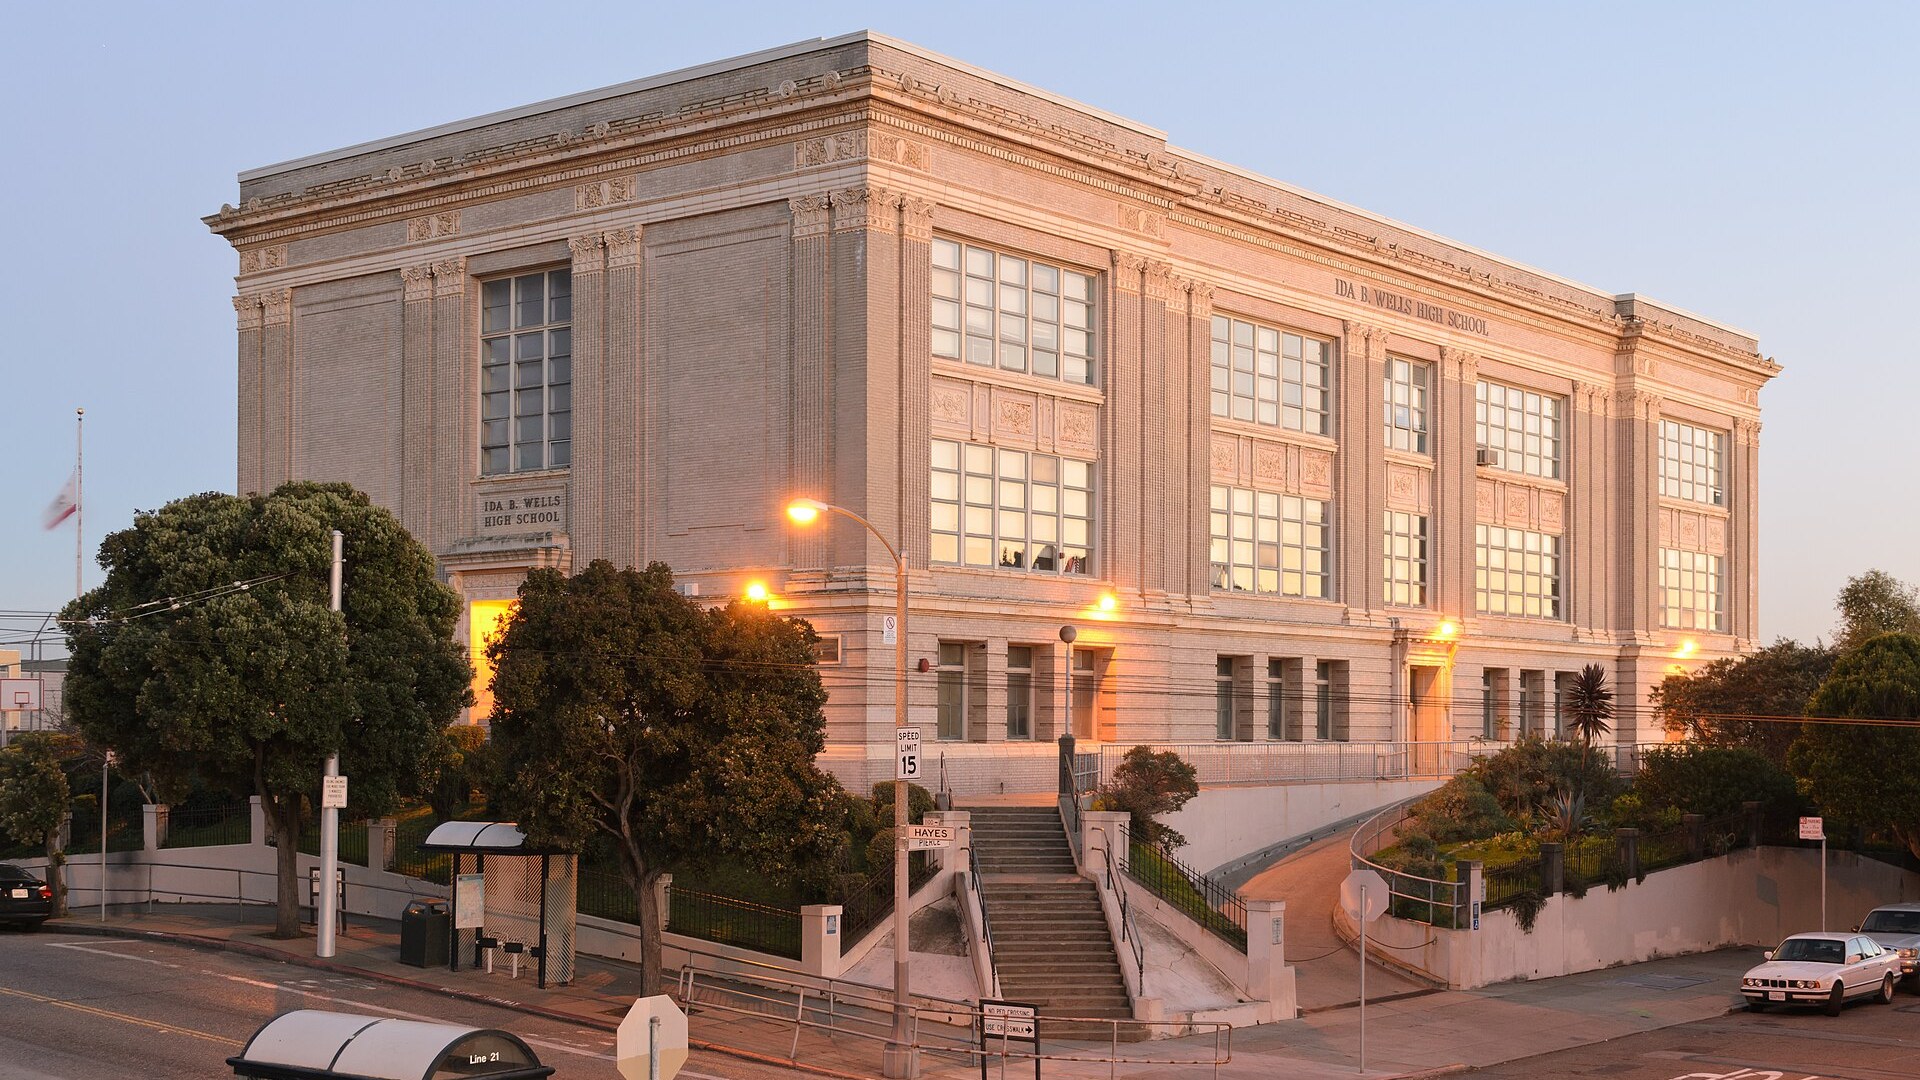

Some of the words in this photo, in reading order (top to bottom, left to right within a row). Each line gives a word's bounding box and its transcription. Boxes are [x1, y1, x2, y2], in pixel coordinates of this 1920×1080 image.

[1335, 278, 1356, 299] IDA
[1360, 285, 1371, 304] B.
[1374, 289, 1412, 315] WELLS
[1416, 301, 1444, 324] HIGH
[1448, 311, 1489, 336] SCHOOL
[484, 501, 503, 511] IDA
[509, 500, 518, 509] B.
[523, 496, 560, 508] WELLS
[484, 515, 511, 527] HIGH
[516, 512, 560, 524] SCHOOL
[898, 732, 919, 740] SPEED
[901, 744, 917, 752] LIMIT
[901, 755, 917, 775] 15
[914, 828, 948, 838] HAYES
[997, 1025, 1025, 1033] CRSSWALK
[470, 1055, 486, 1064] Line
[490, 1051, 500, 1062] 21
